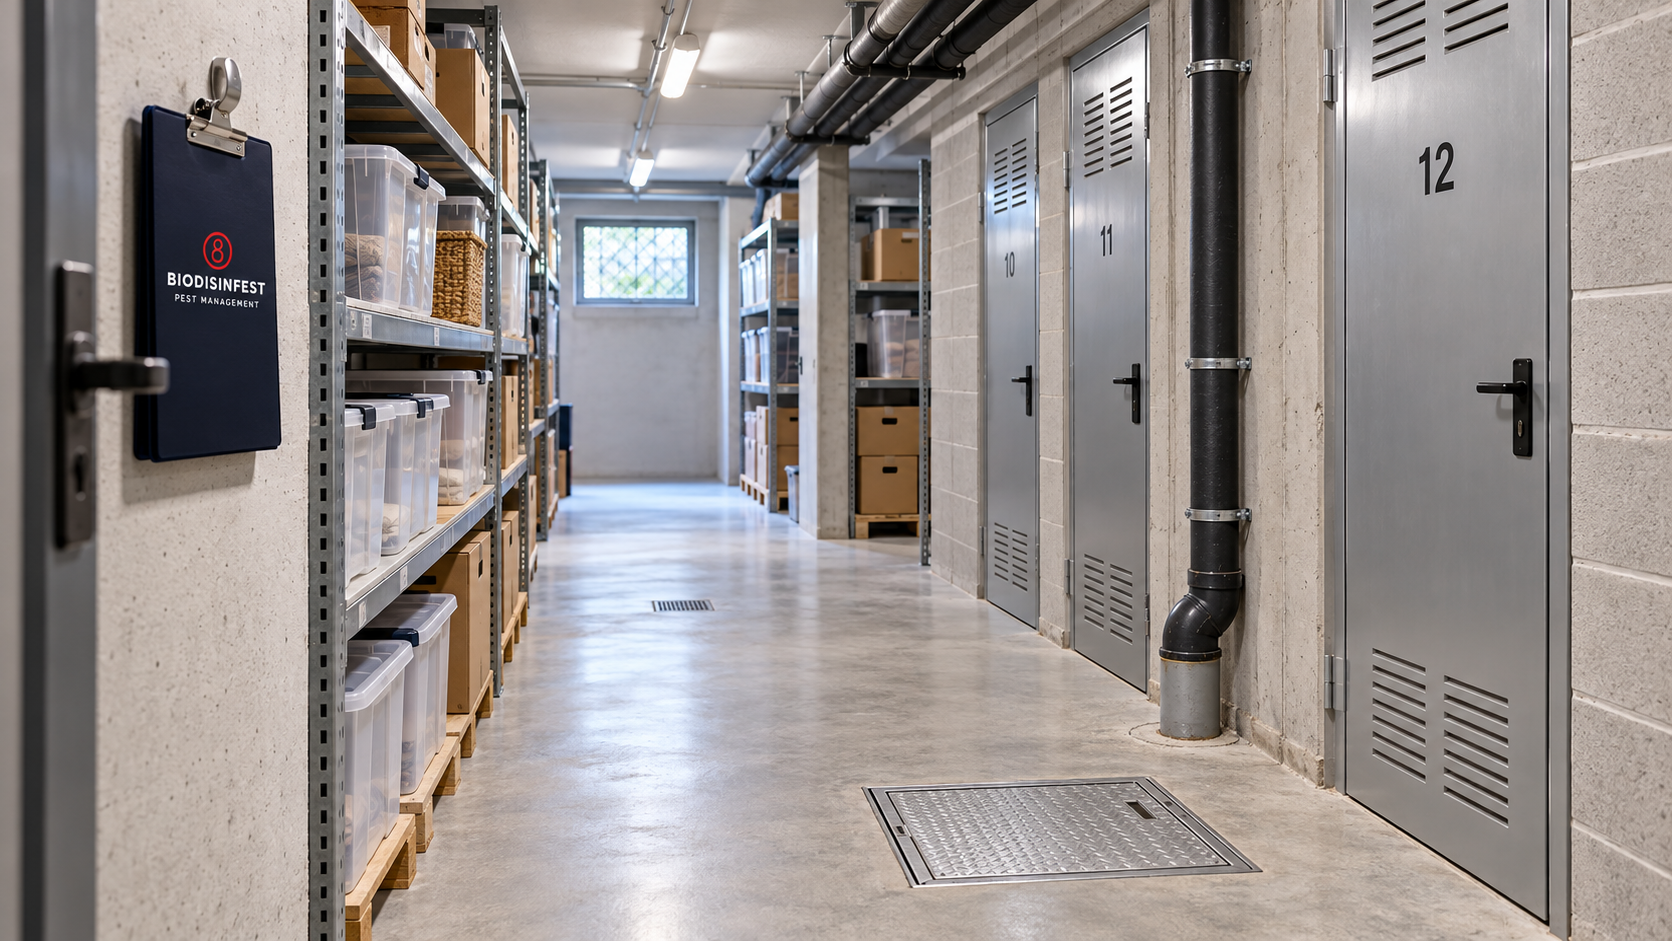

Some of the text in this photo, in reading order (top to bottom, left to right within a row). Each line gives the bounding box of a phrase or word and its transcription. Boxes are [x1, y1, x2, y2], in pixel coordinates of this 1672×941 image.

[1418, 141, 1455, 196] 12
[1100, 223, 1113, 257] 11
[1004, 251, 1016, 278] 10
[167, 271, 266, 296] BIODISINFEST
[174, 293, 260, 309] PEST MANAGEMENT
